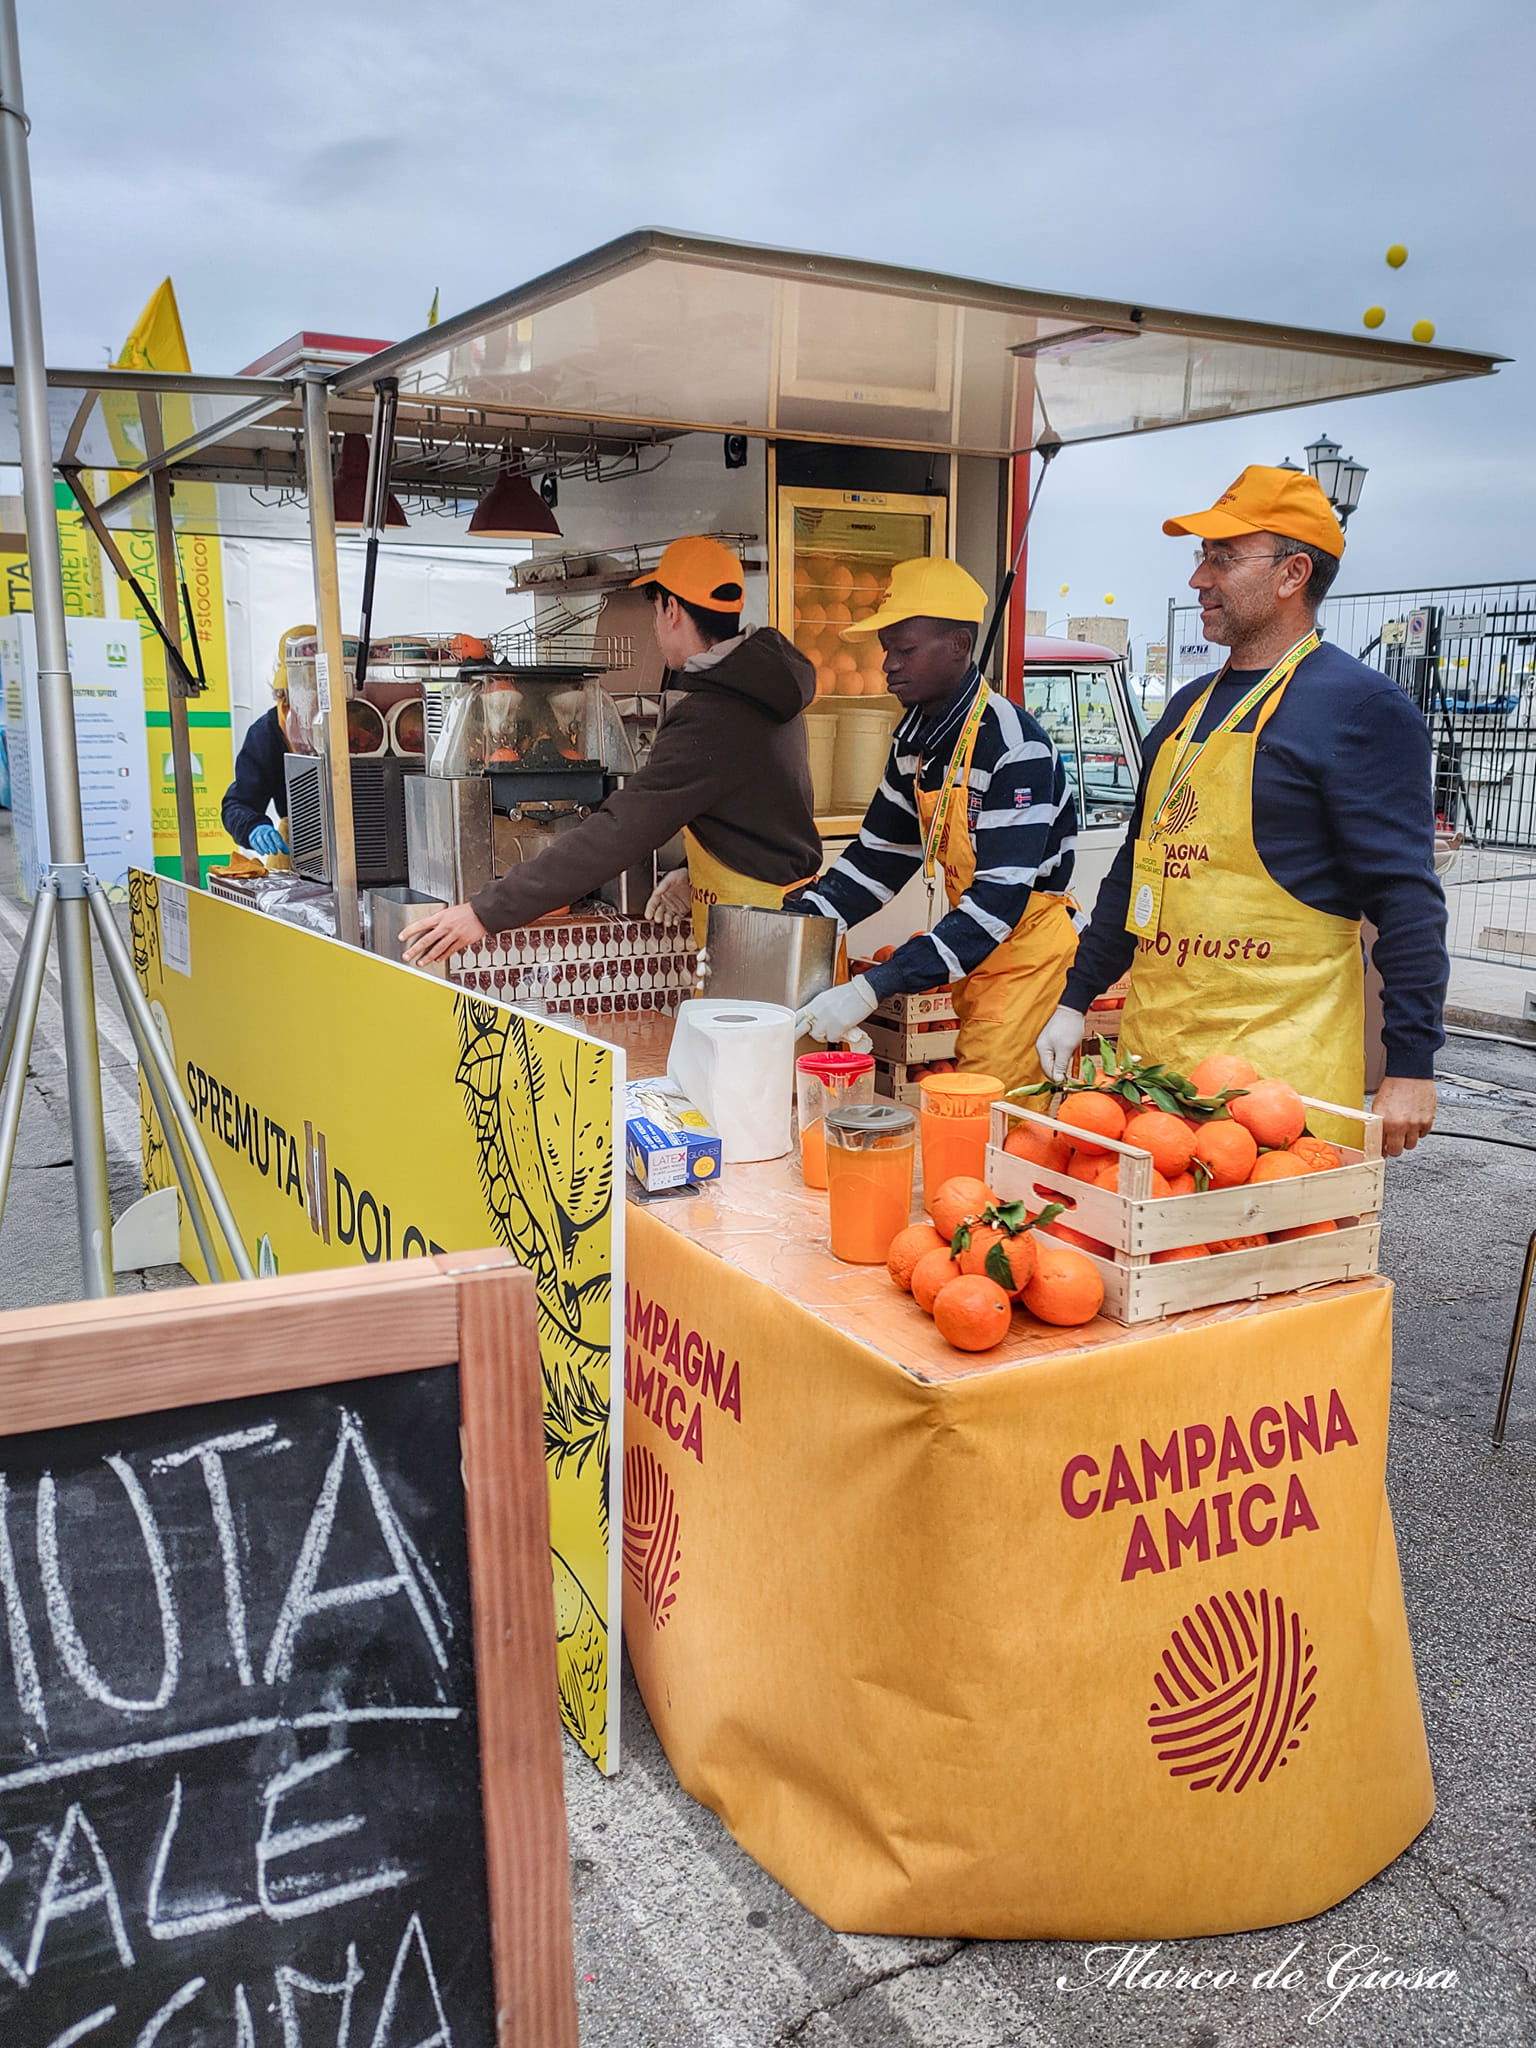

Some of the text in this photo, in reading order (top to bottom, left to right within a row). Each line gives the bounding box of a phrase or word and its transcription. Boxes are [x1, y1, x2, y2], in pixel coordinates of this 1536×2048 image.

[186, 1060, 304, 1208] SPREMUTA
[652, 1152, 686, 1168] LATEX
[1061, 1387, 1359, 1519] CAMPAGNA
[1120, 1473, 1320, 1583] AMICA
